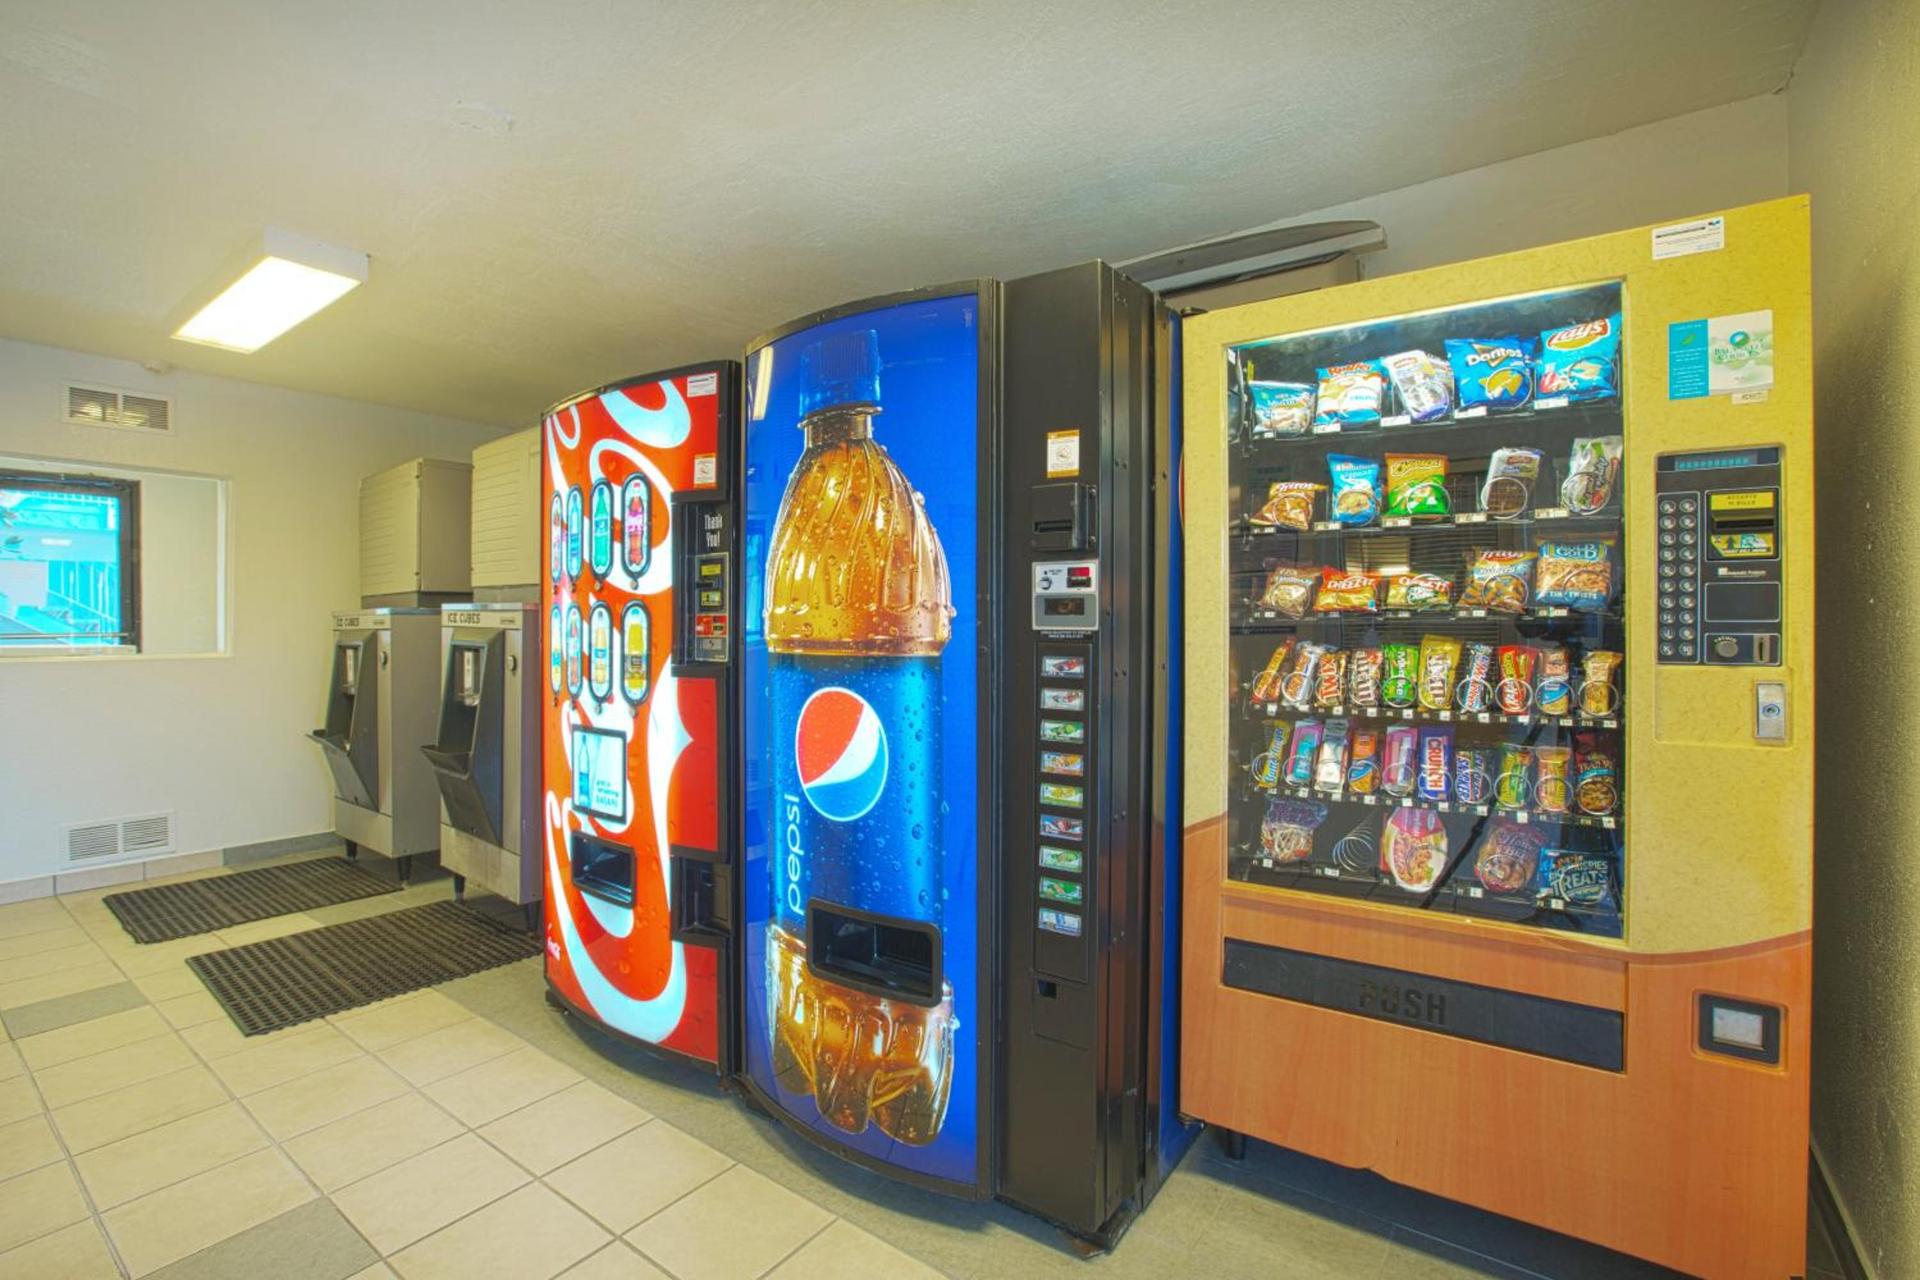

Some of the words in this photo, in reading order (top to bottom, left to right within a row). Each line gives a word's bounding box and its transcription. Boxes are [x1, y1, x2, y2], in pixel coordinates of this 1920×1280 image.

[1465, 348, 1524, 367] Doritos
[704, 513, 722, 530] Thank
[706, 531, 720, 547] You!
[460, 613, 481, 625] CUBES
[1428, 739, 1443, 788] CRUNCH
[784, 793, 804, 915] pepsi
[1550, 868, 1609, 897] TREATS
[1359, 981, 1446, 1026] PUSH
